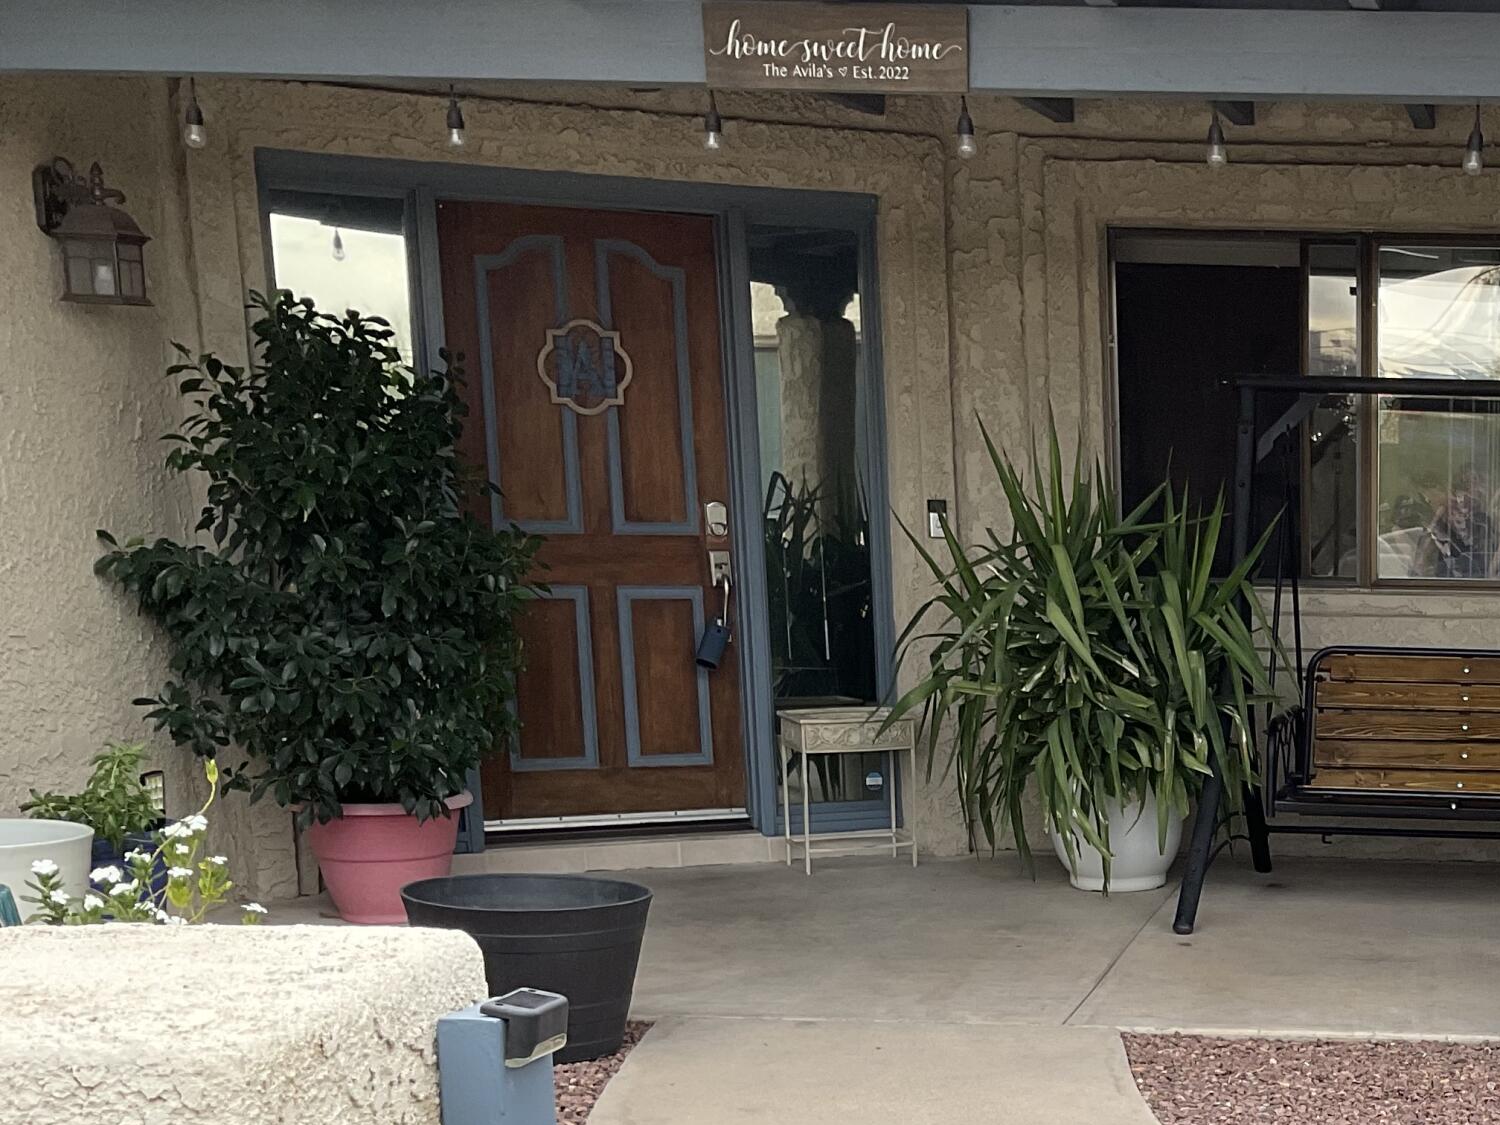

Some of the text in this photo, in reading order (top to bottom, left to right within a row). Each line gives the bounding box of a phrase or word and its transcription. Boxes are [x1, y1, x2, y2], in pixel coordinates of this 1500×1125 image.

[709, 19, 962, 62] home sweet home
[763, 63, 787, 77] The
[793, 64, 833, 78] Avila's
[879, 66, 909, 80] 2022
